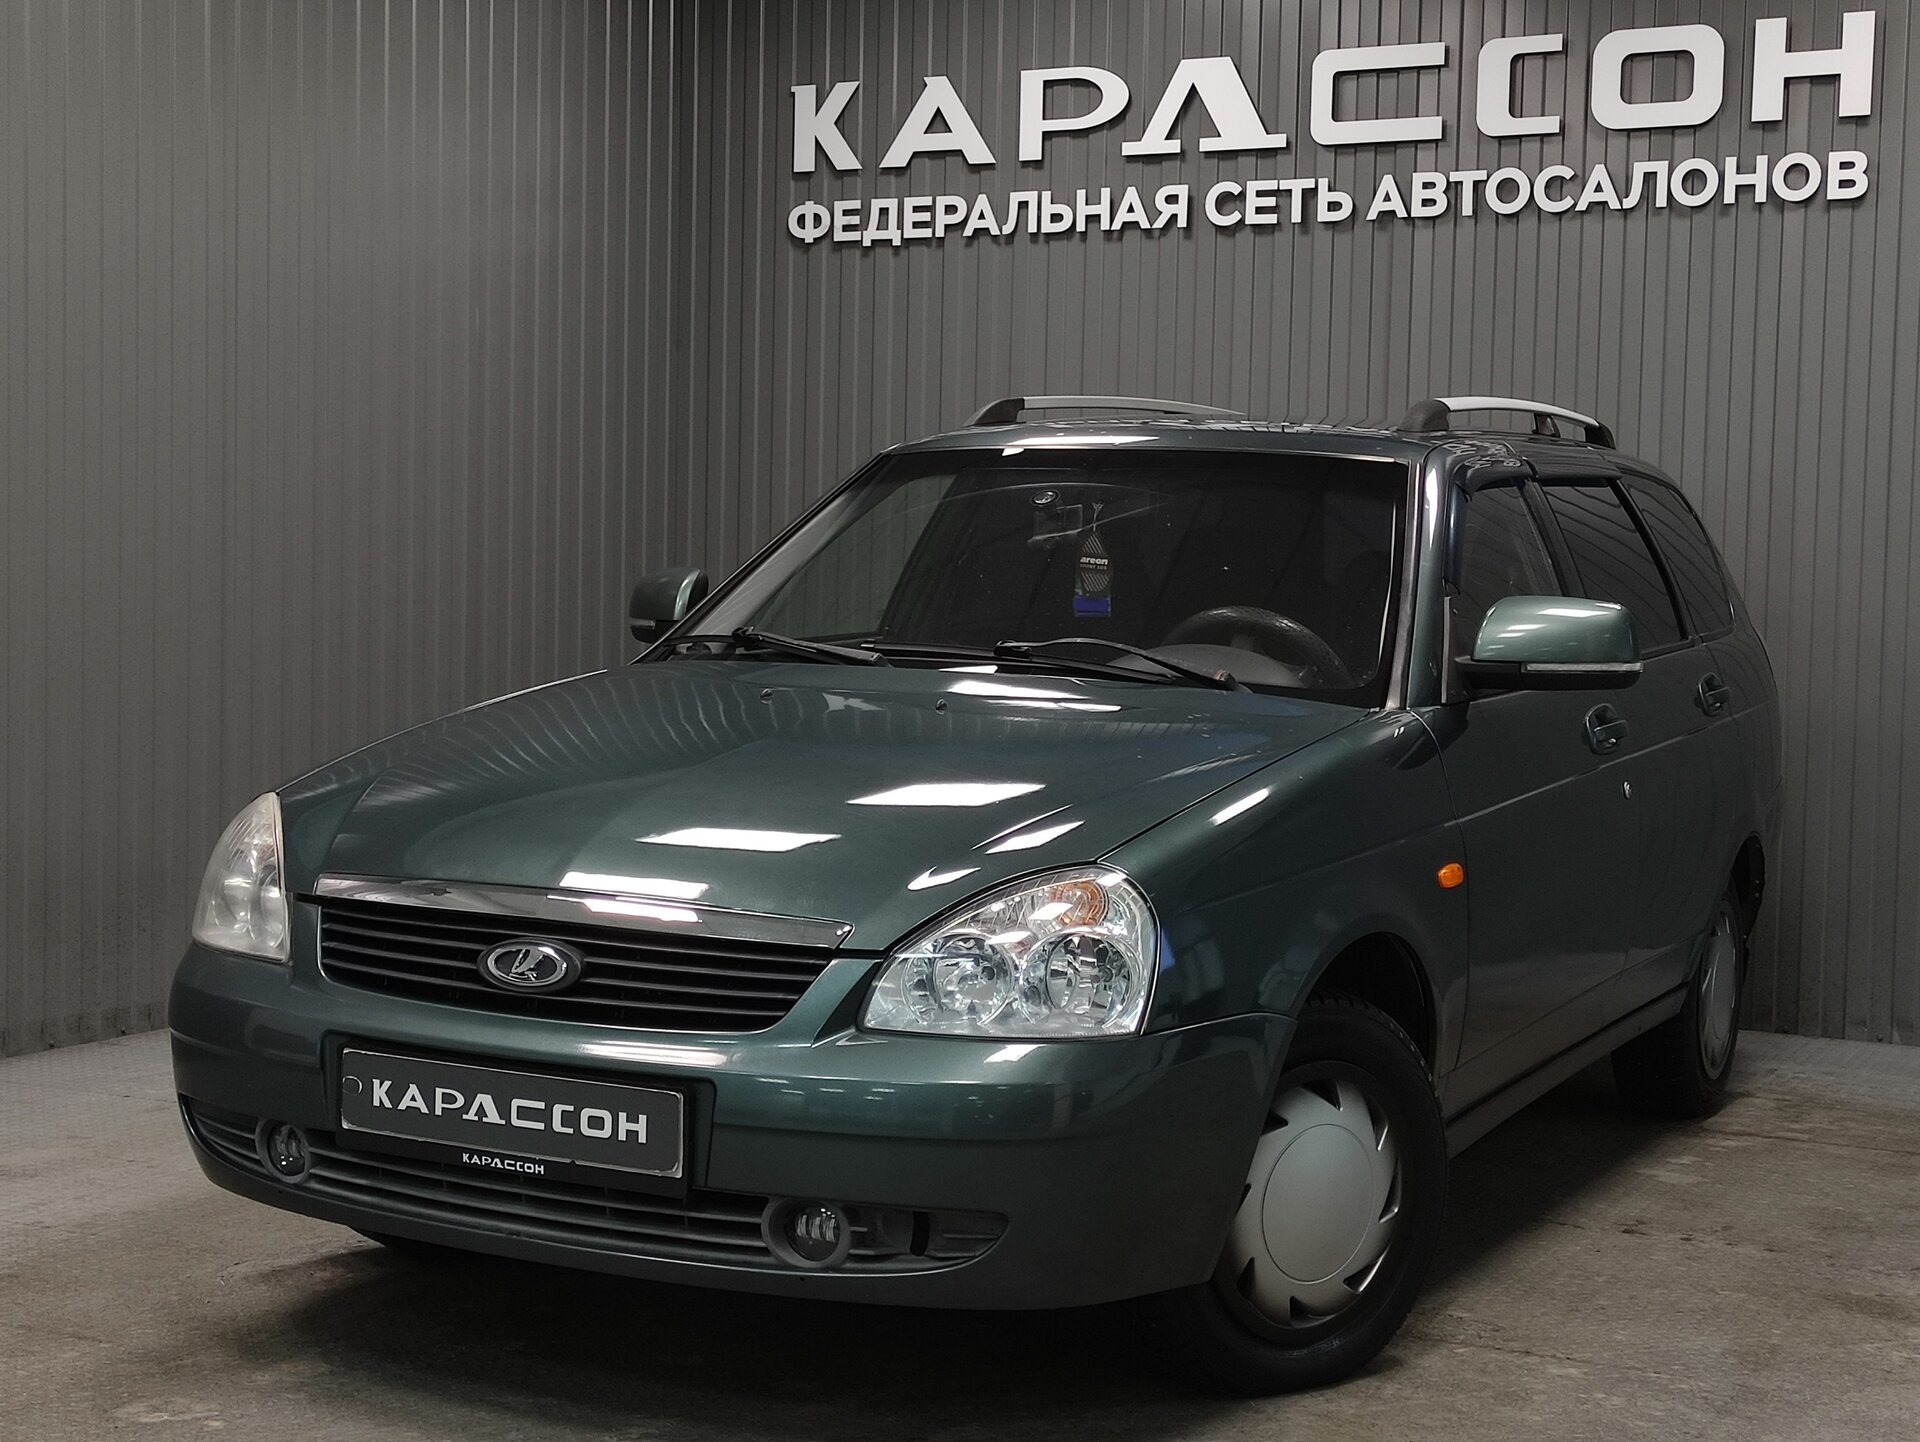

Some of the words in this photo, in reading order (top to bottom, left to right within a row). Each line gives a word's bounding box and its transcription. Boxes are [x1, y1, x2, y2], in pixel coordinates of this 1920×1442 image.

[788, 184, 1189, 246] ФЕДЕРАЛЬНАЯ
[1204, 177, 1353, 226] СЕТЬ
[1366, 151, 1869, 221] АВТОСАЛОНОВ
